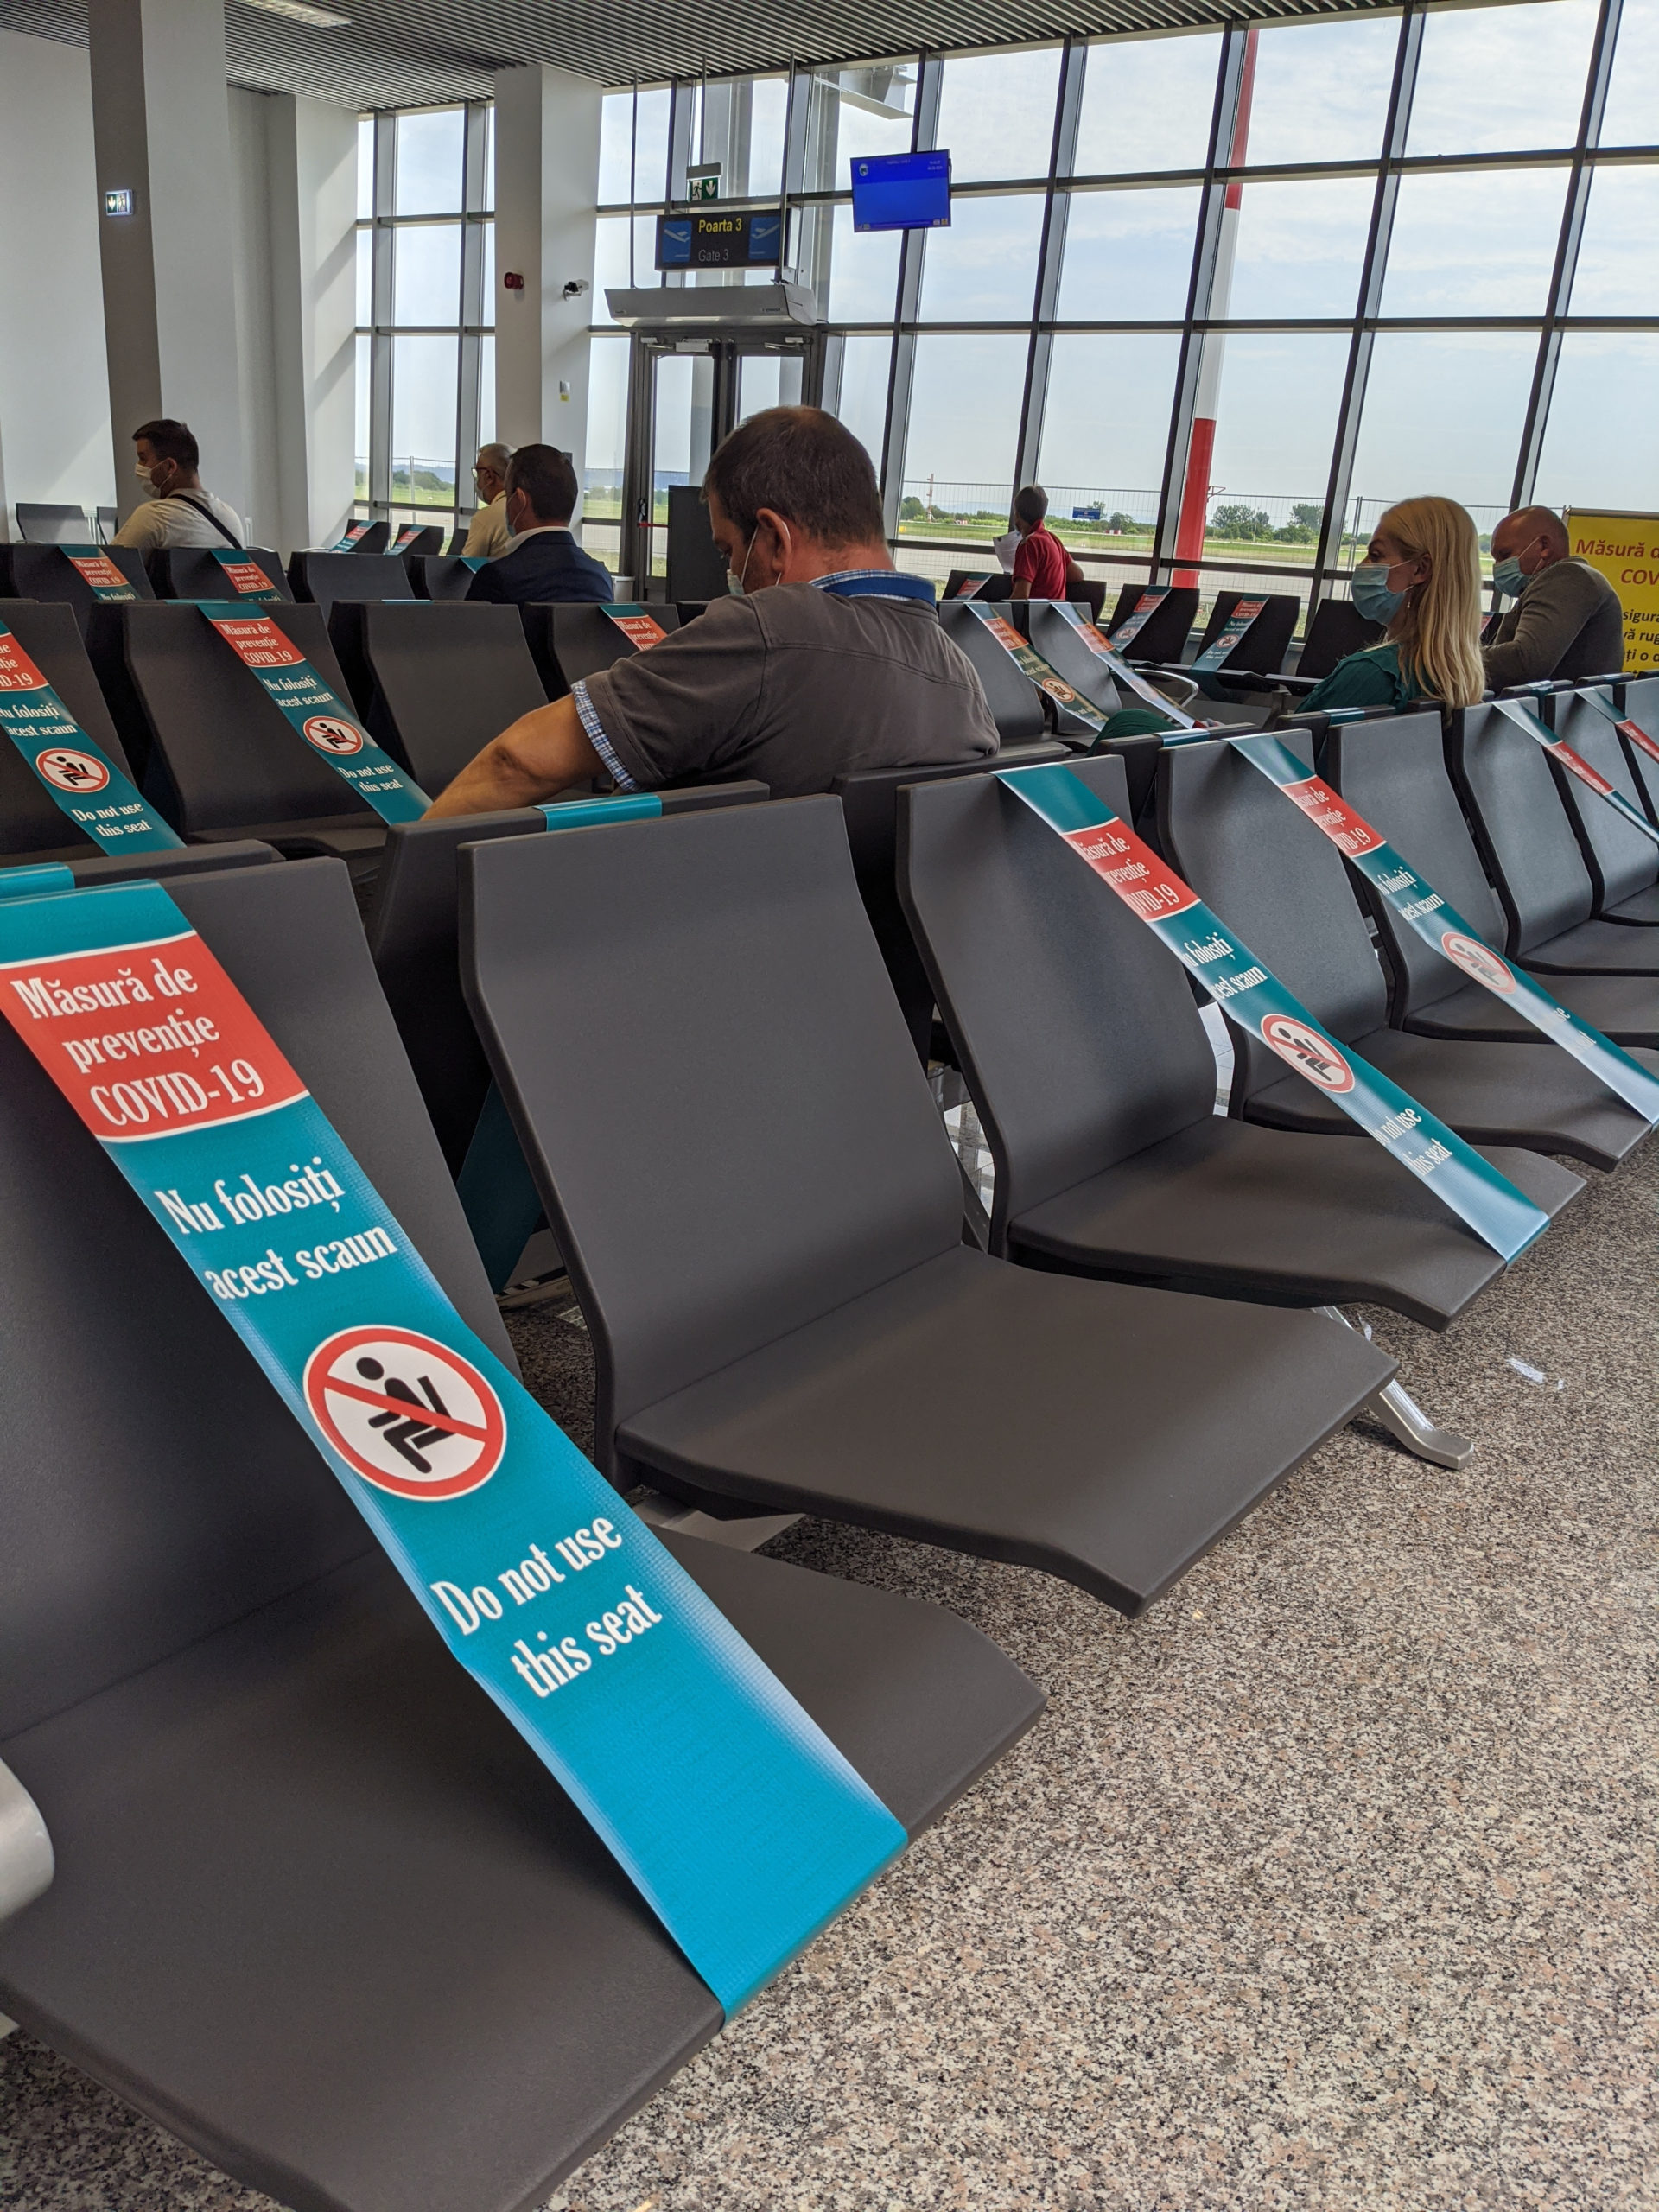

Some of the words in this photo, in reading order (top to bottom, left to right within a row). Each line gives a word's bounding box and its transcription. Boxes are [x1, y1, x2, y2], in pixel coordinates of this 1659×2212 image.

[698, 219, 733, 233] Poarta
[735, 217, 742, 232] 3
[698, 249, 721, 262] Gate
[723, 248, 729, 261] 3
[1575, 539, 1645, 559] Măsură
[220, 623, 258, 635] Măsură
[257, 622, 271, 634] de
[243, 650, 293, 664] COVID-19
[263, 678, 282, 691] Nu
[279, 675, 317, 690] folosiți
[276, 696, 303, 707] acest
[302, 692, 334, 705] scaun
[12, 702, 60, 720] folosiți
[6, 725, 40, 736] acest
[39, 724, 78, 735] scaun
[336, 767, 357, 779] Do
[355, 766, 376, 777] not
[373, 765, 394, 775] use
[358, 781, 381, 792] this
[380, 779, 404, 790] seat
[71, 809, 97, 822] Do
[95, 805, 120, 818] not
[118, 803, 143, 815] use
[95, 823, 124, 836] this
[124, 819, 153, 833] seat
[1105, 832, 1131, 853] de
[1184, 931, 1236, 964] folosiți
[10, 966, 155, 1020] Măsură
[150, 957, 198, 994] de
[1230, 966, 1268, 991] scaun
[61, 1007, 220, 1074] prevenție
[90, 1058, 264, 1127] COVID-19
[1381, 1116, 1406, 1140] not
[1395, 1108, 1422, 1130] use
[1424, 1137, 1452, 1165] seat
[154, 1189, 225, 1235] Nu
[213, 1155, 346, 1226] folosiți
[204, 1249, 298, 1300] acest
[295, 1225, 397, 1279] scaun
[430, 1580, 504, 1637] Do
[497, 1542, 566, 1606] not
[555, 1516, 622, 1572] use
[511, 1630, 592, 1699] this
[585, 1584, 663, 1656] seat
